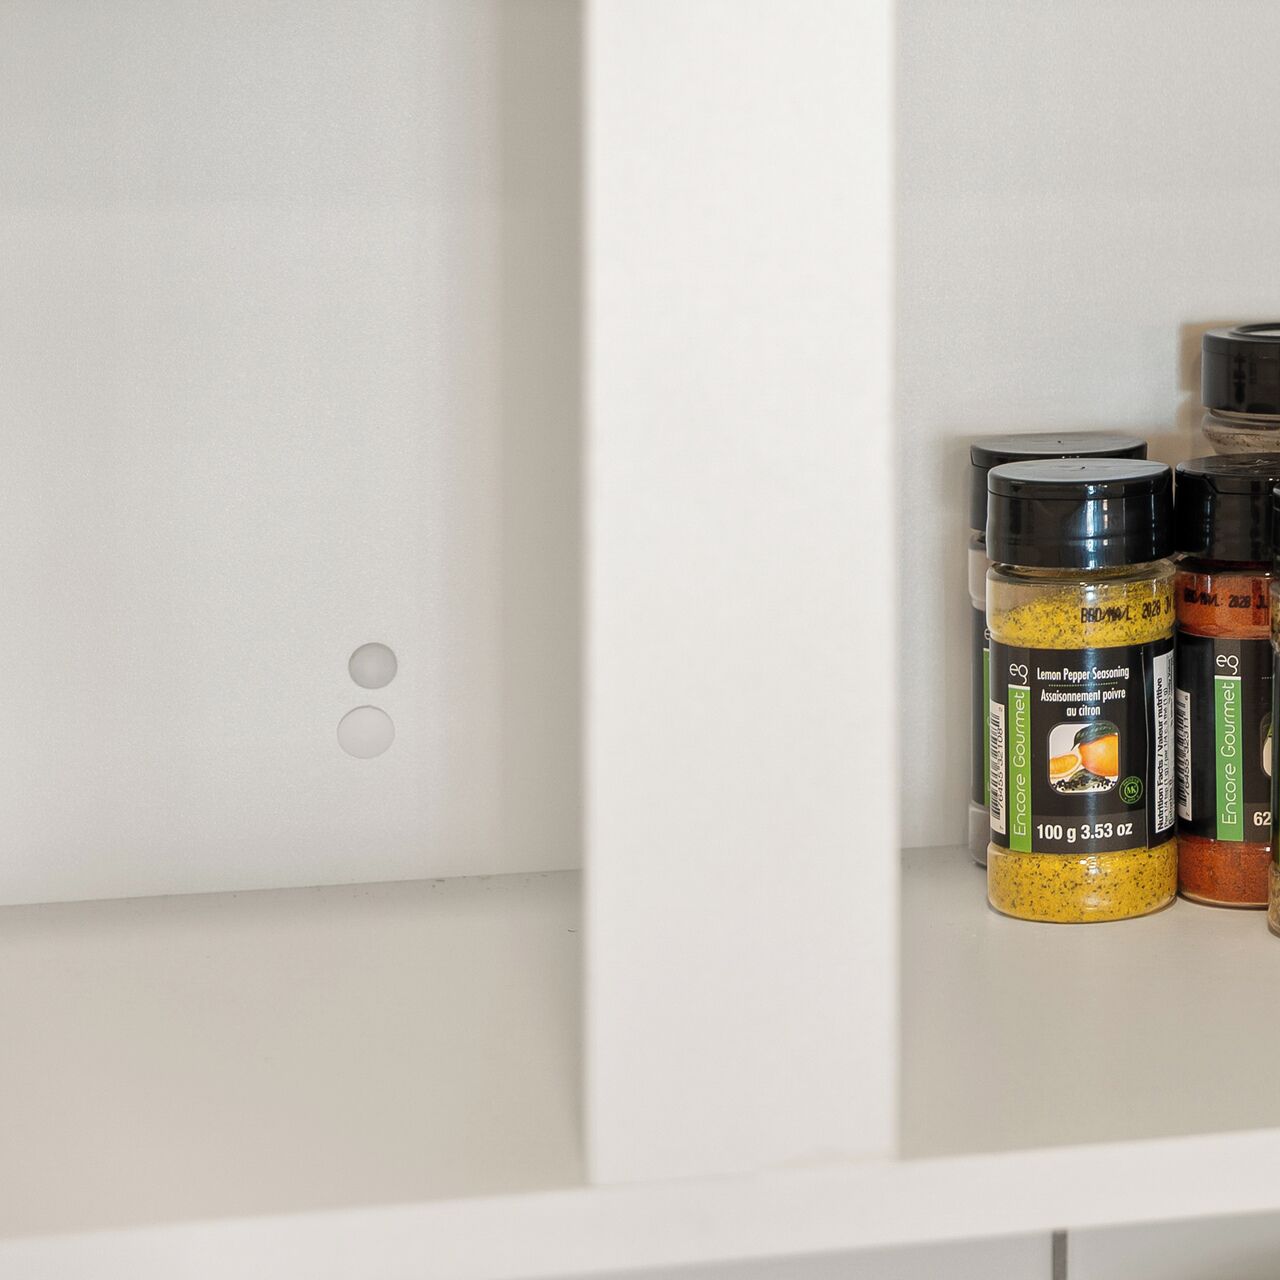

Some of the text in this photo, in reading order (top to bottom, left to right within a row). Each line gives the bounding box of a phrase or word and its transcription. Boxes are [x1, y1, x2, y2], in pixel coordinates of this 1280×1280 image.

[1036, 665, 1130, 683] Lemon Pepper Seasoning
[1041, 688, 1126, 703] Assaisonnement poivre
[1066, 704, 1101, 717] au citron
[1220, 681, 1237, 825] Encore Gourmet
[1012, 691, 1027, 836] Encore Gourmet
[1036, 822, 1133, 843] 100 g 3.53 oz
